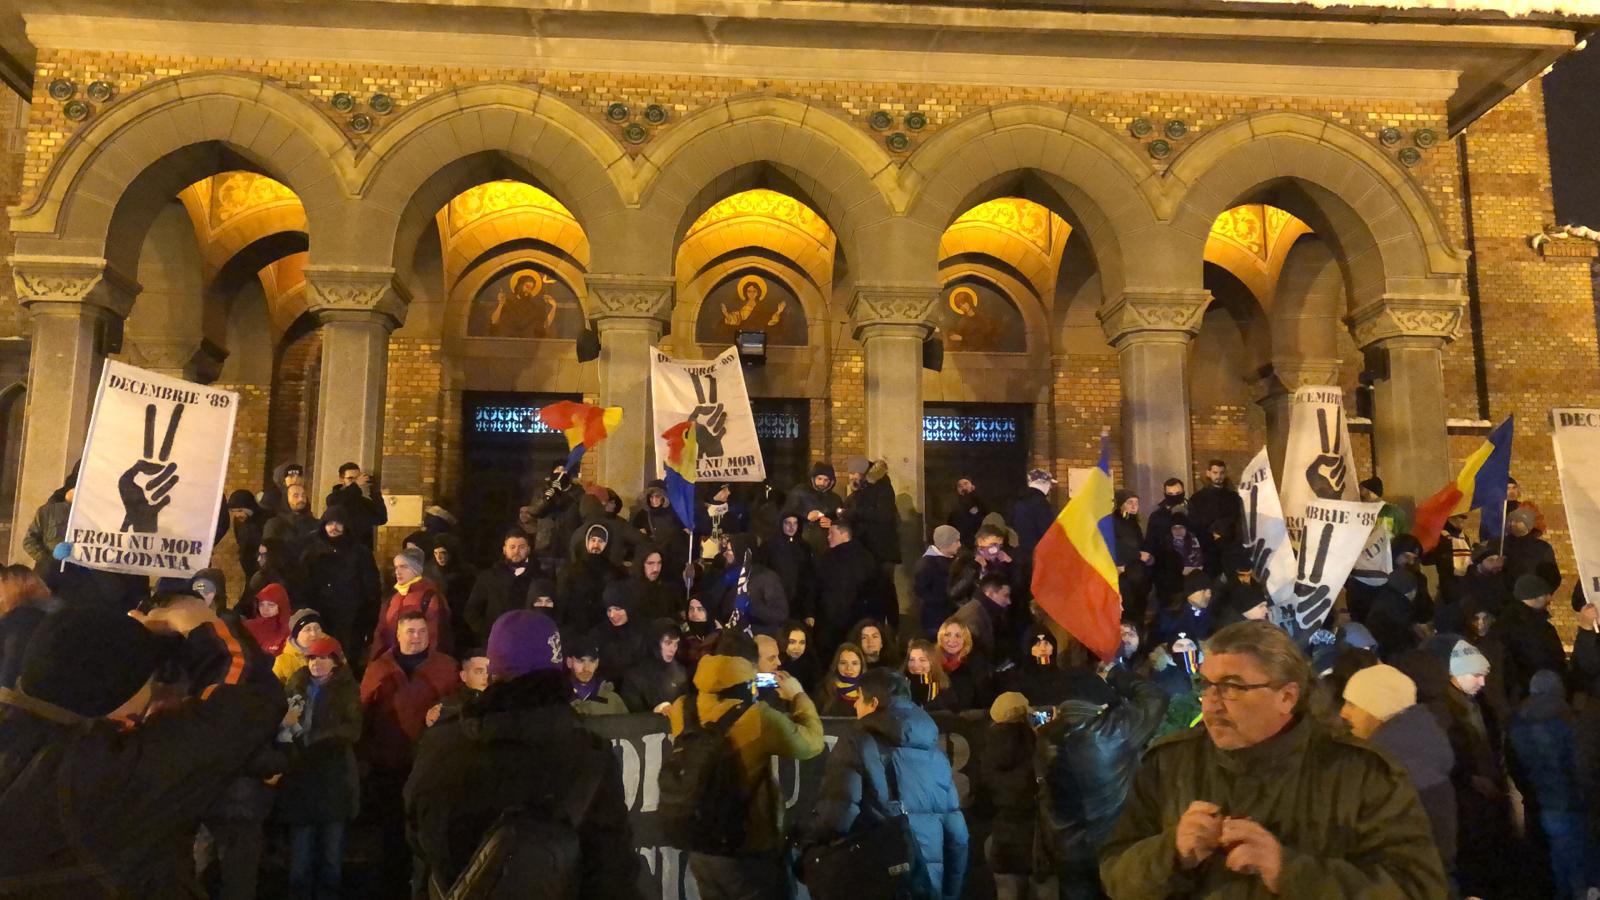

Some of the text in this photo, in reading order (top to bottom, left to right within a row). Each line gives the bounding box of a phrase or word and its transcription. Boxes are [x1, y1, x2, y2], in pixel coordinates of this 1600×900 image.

[108, 374, 200, 405] DECEMBRIE
[705, 458, 722, 469] NU
[727, 455, 755, 467] MOR
[128, 534, 154, 551] NU
[161, 537, 202, 555] MOR
[80, 545, 191, 571] NICIODATA
